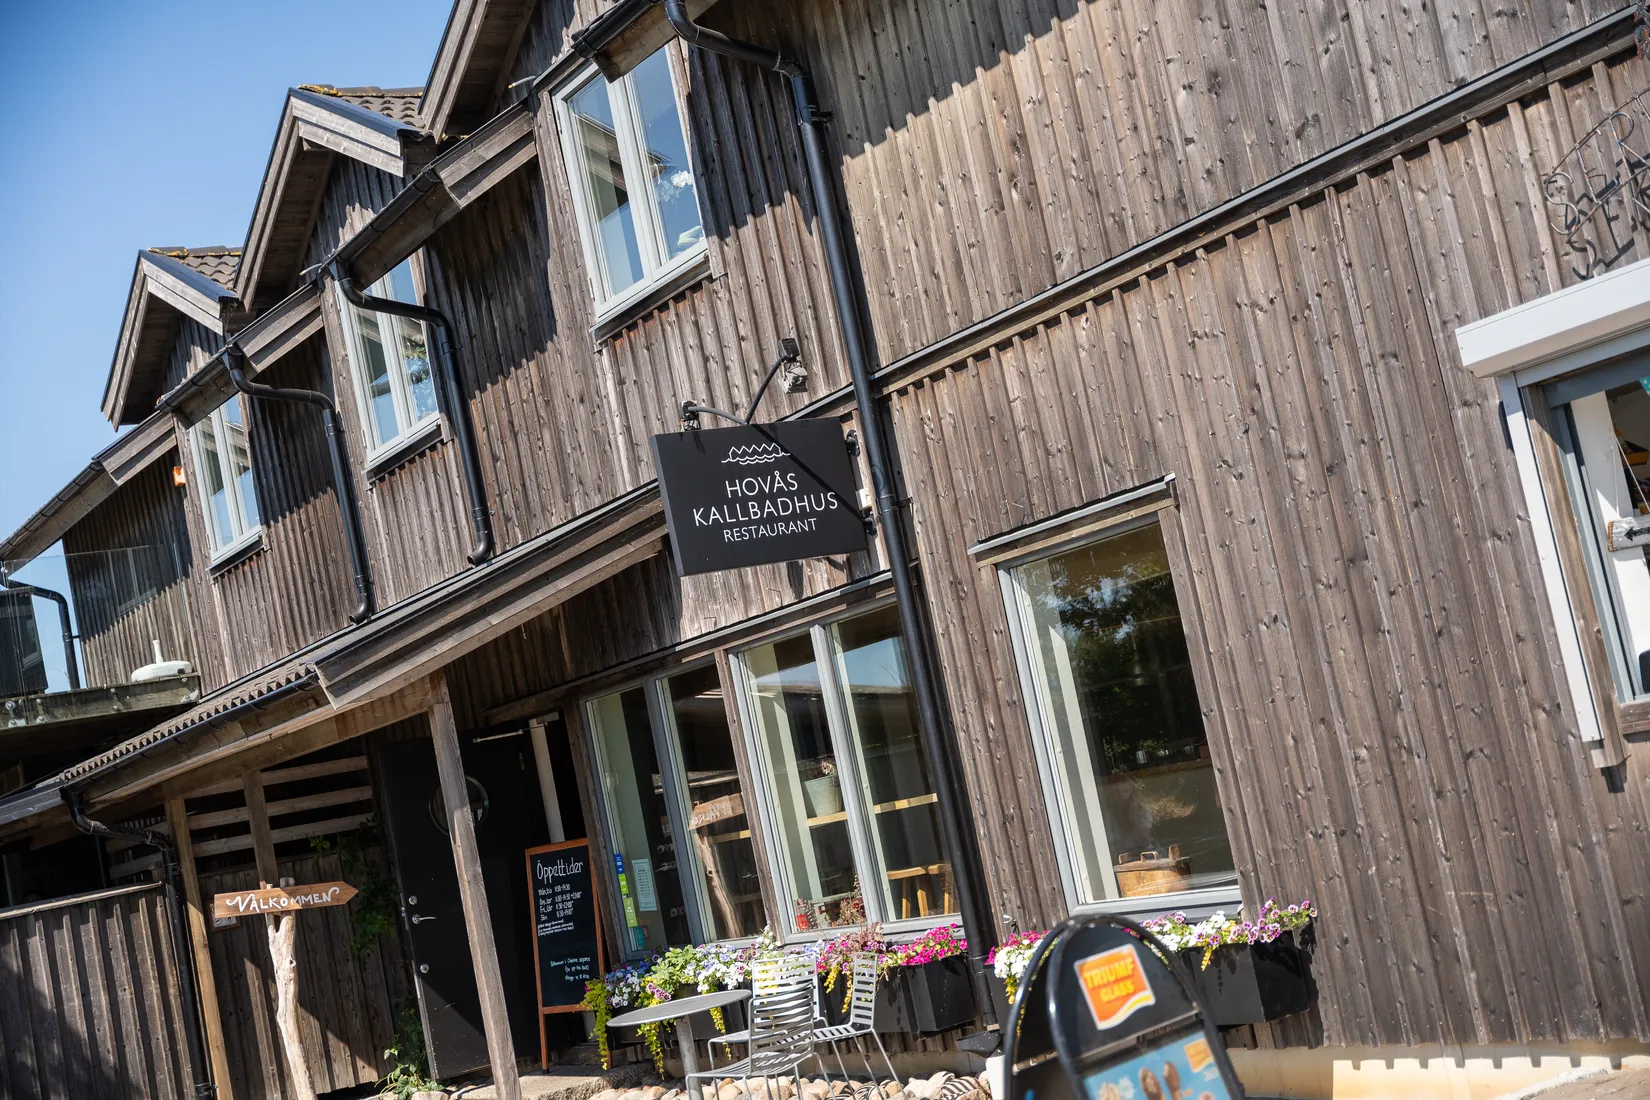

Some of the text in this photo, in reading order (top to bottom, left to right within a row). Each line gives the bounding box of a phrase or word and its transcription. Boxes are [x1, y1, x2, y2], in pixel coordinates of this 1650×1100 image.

[725, 470, 798, 498] HOVÅS
[693, 491, 838, 527] KALLBADHUS
[723, 518, 817, 542] RESTAURANT
[537, 857, 583, 884] Öppettider
[1083, 958, 1135, 989] TRIUMF
[1101, 981, 1135, 1004] GLASS
